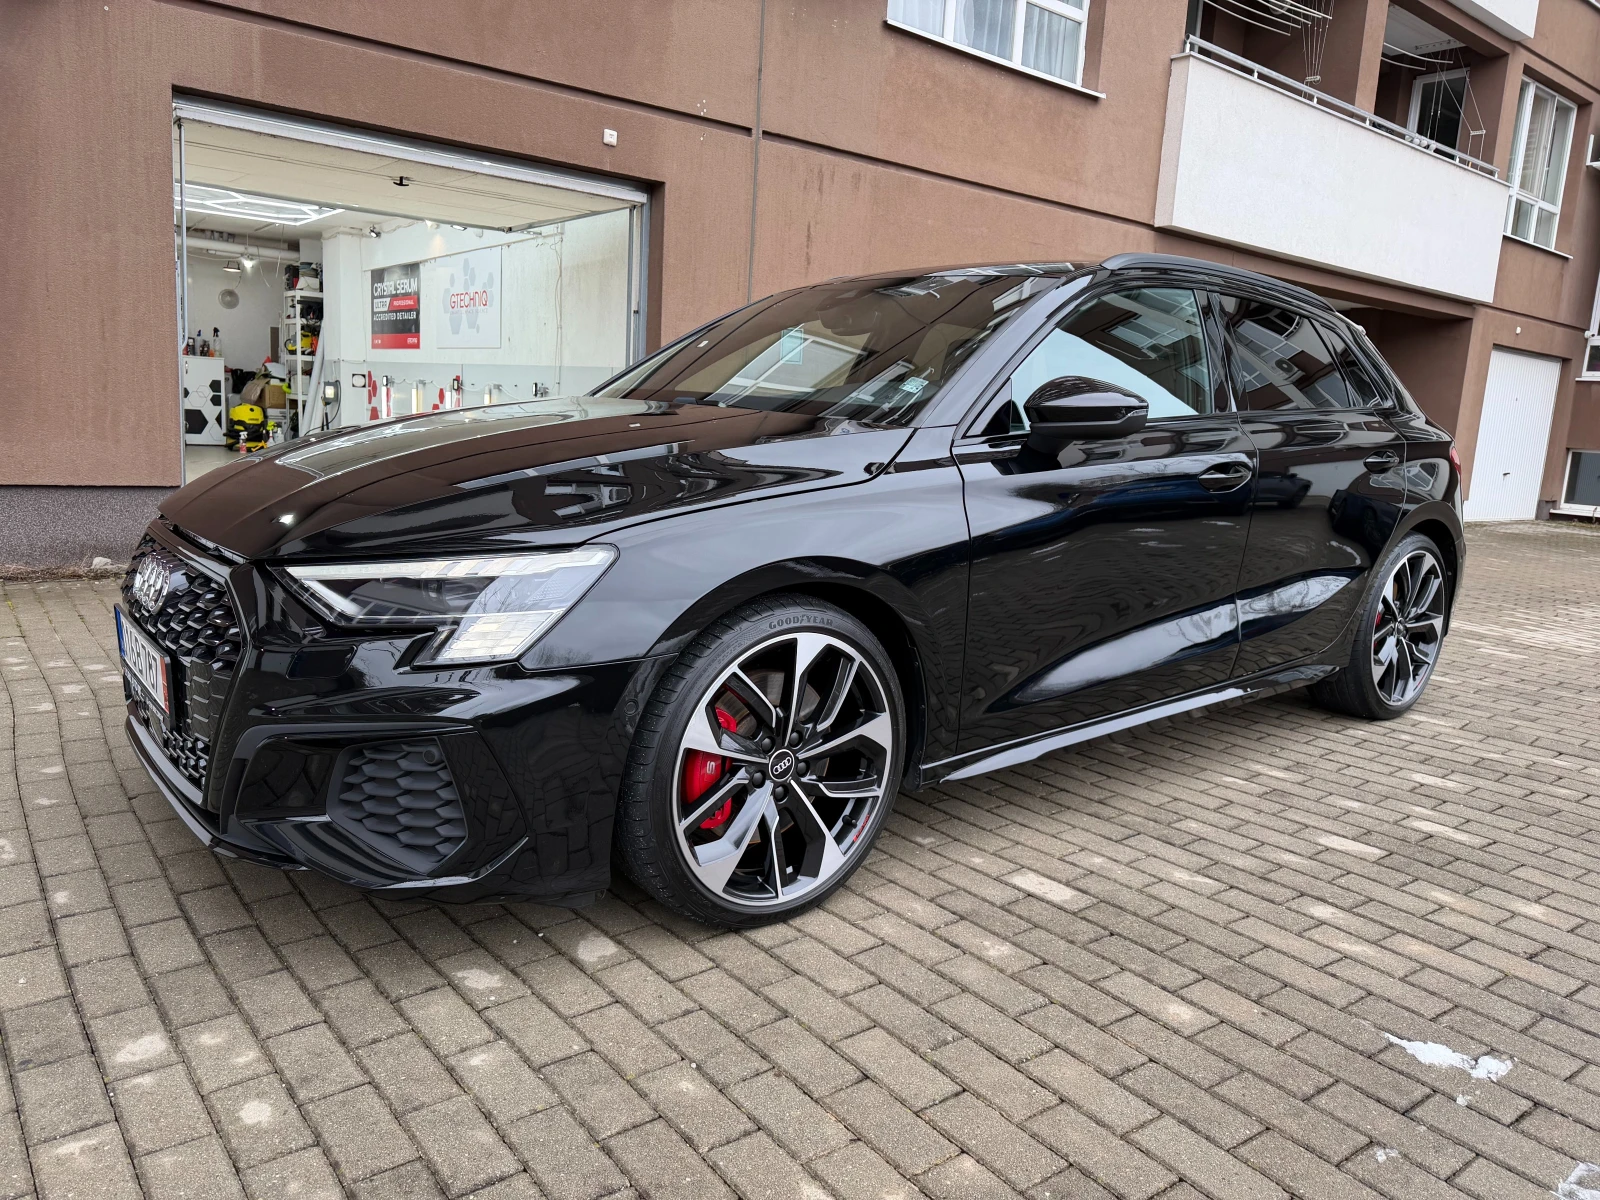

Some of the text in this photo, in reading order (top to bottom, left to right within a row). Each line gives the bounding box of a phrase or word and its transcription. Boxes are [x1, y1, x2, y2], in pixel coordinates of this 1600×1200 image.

[396, 277, 418, 294] SERUM
[450, 289, 488, 309] GTECHNIQ
[396, 311, 417, 320] DETAILER
[768, 614, 833, 630] GOODYEAR
